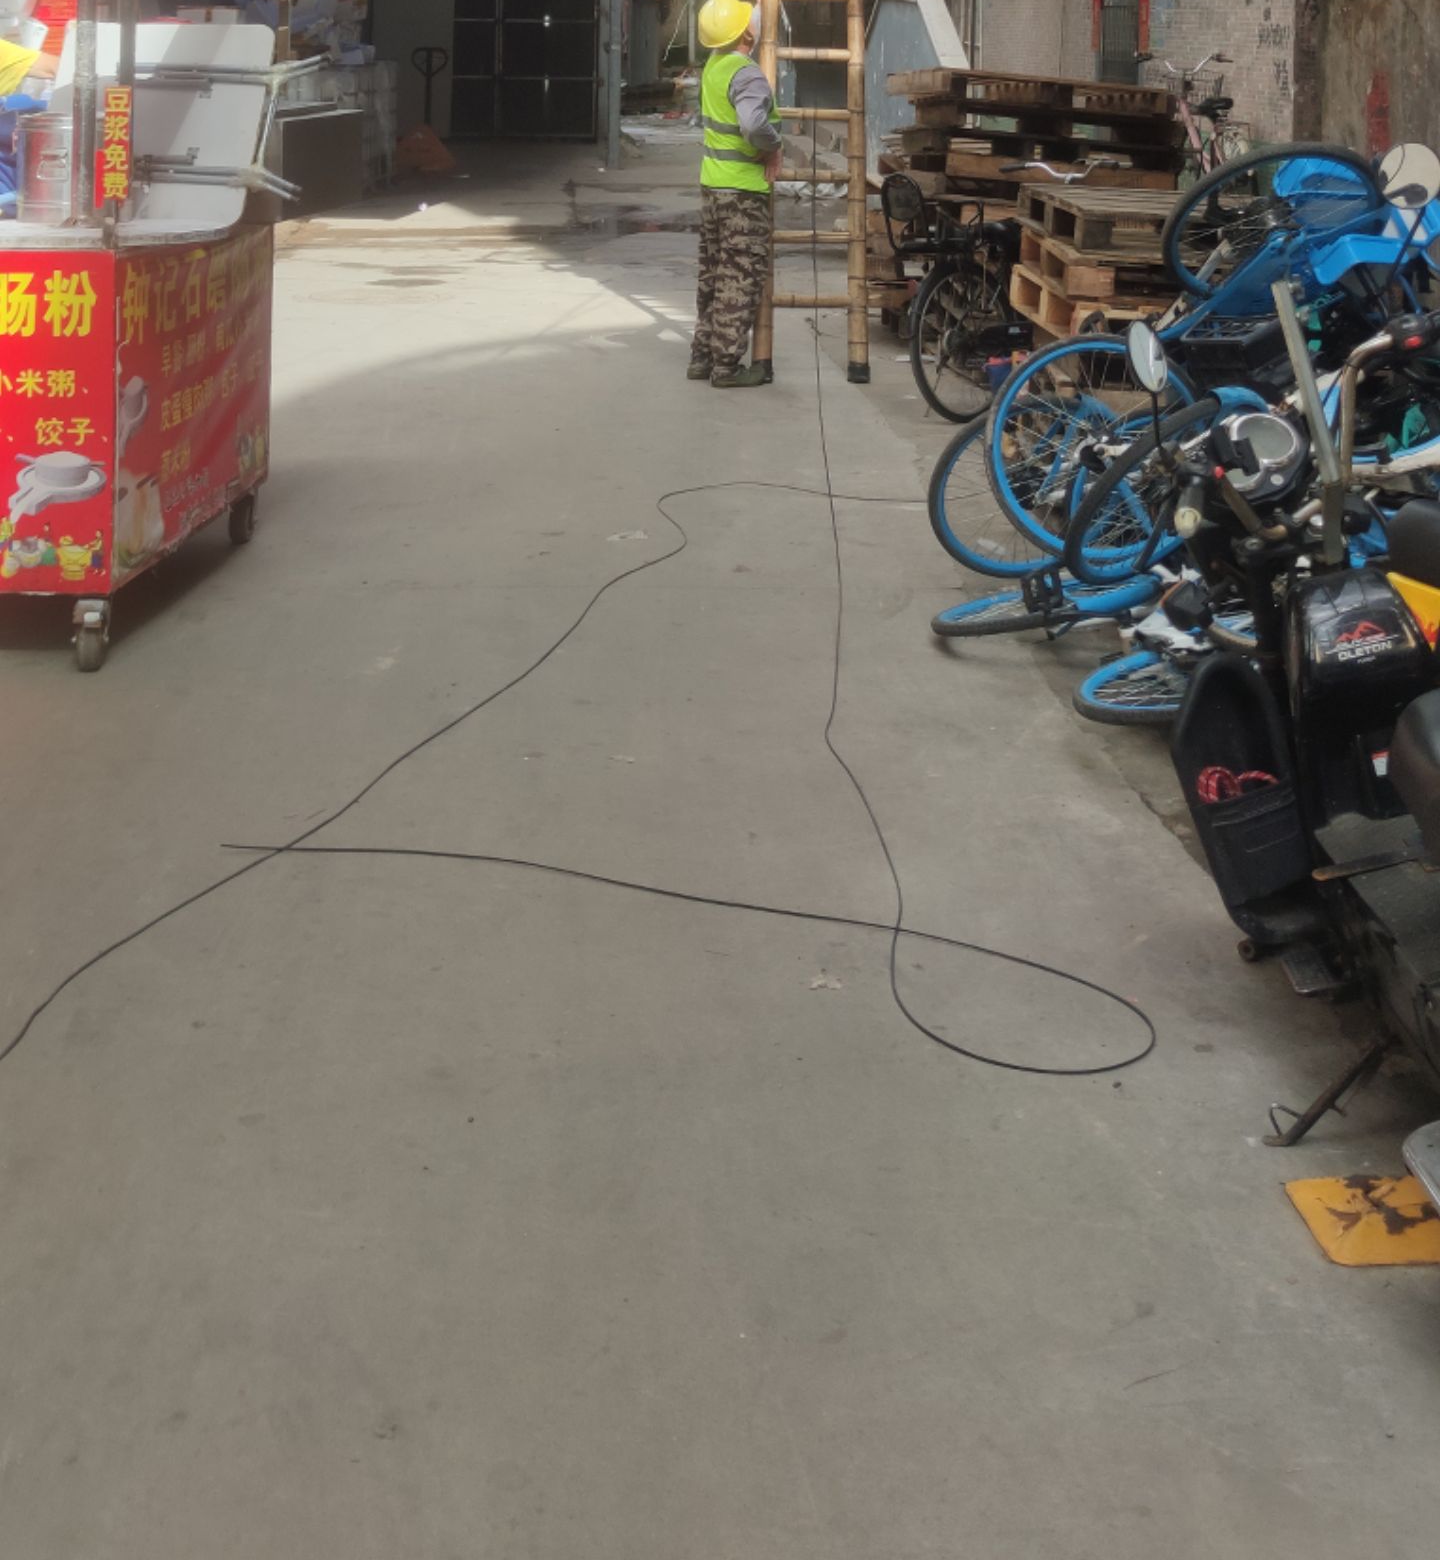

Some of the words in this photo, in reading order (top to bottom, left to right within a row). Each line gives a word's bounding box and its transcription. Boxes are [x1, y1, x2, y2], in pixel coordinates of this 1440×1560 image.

[103, 88, 131, 199] 豆浆免费
[0, 270, 97, 337] 肠粉
